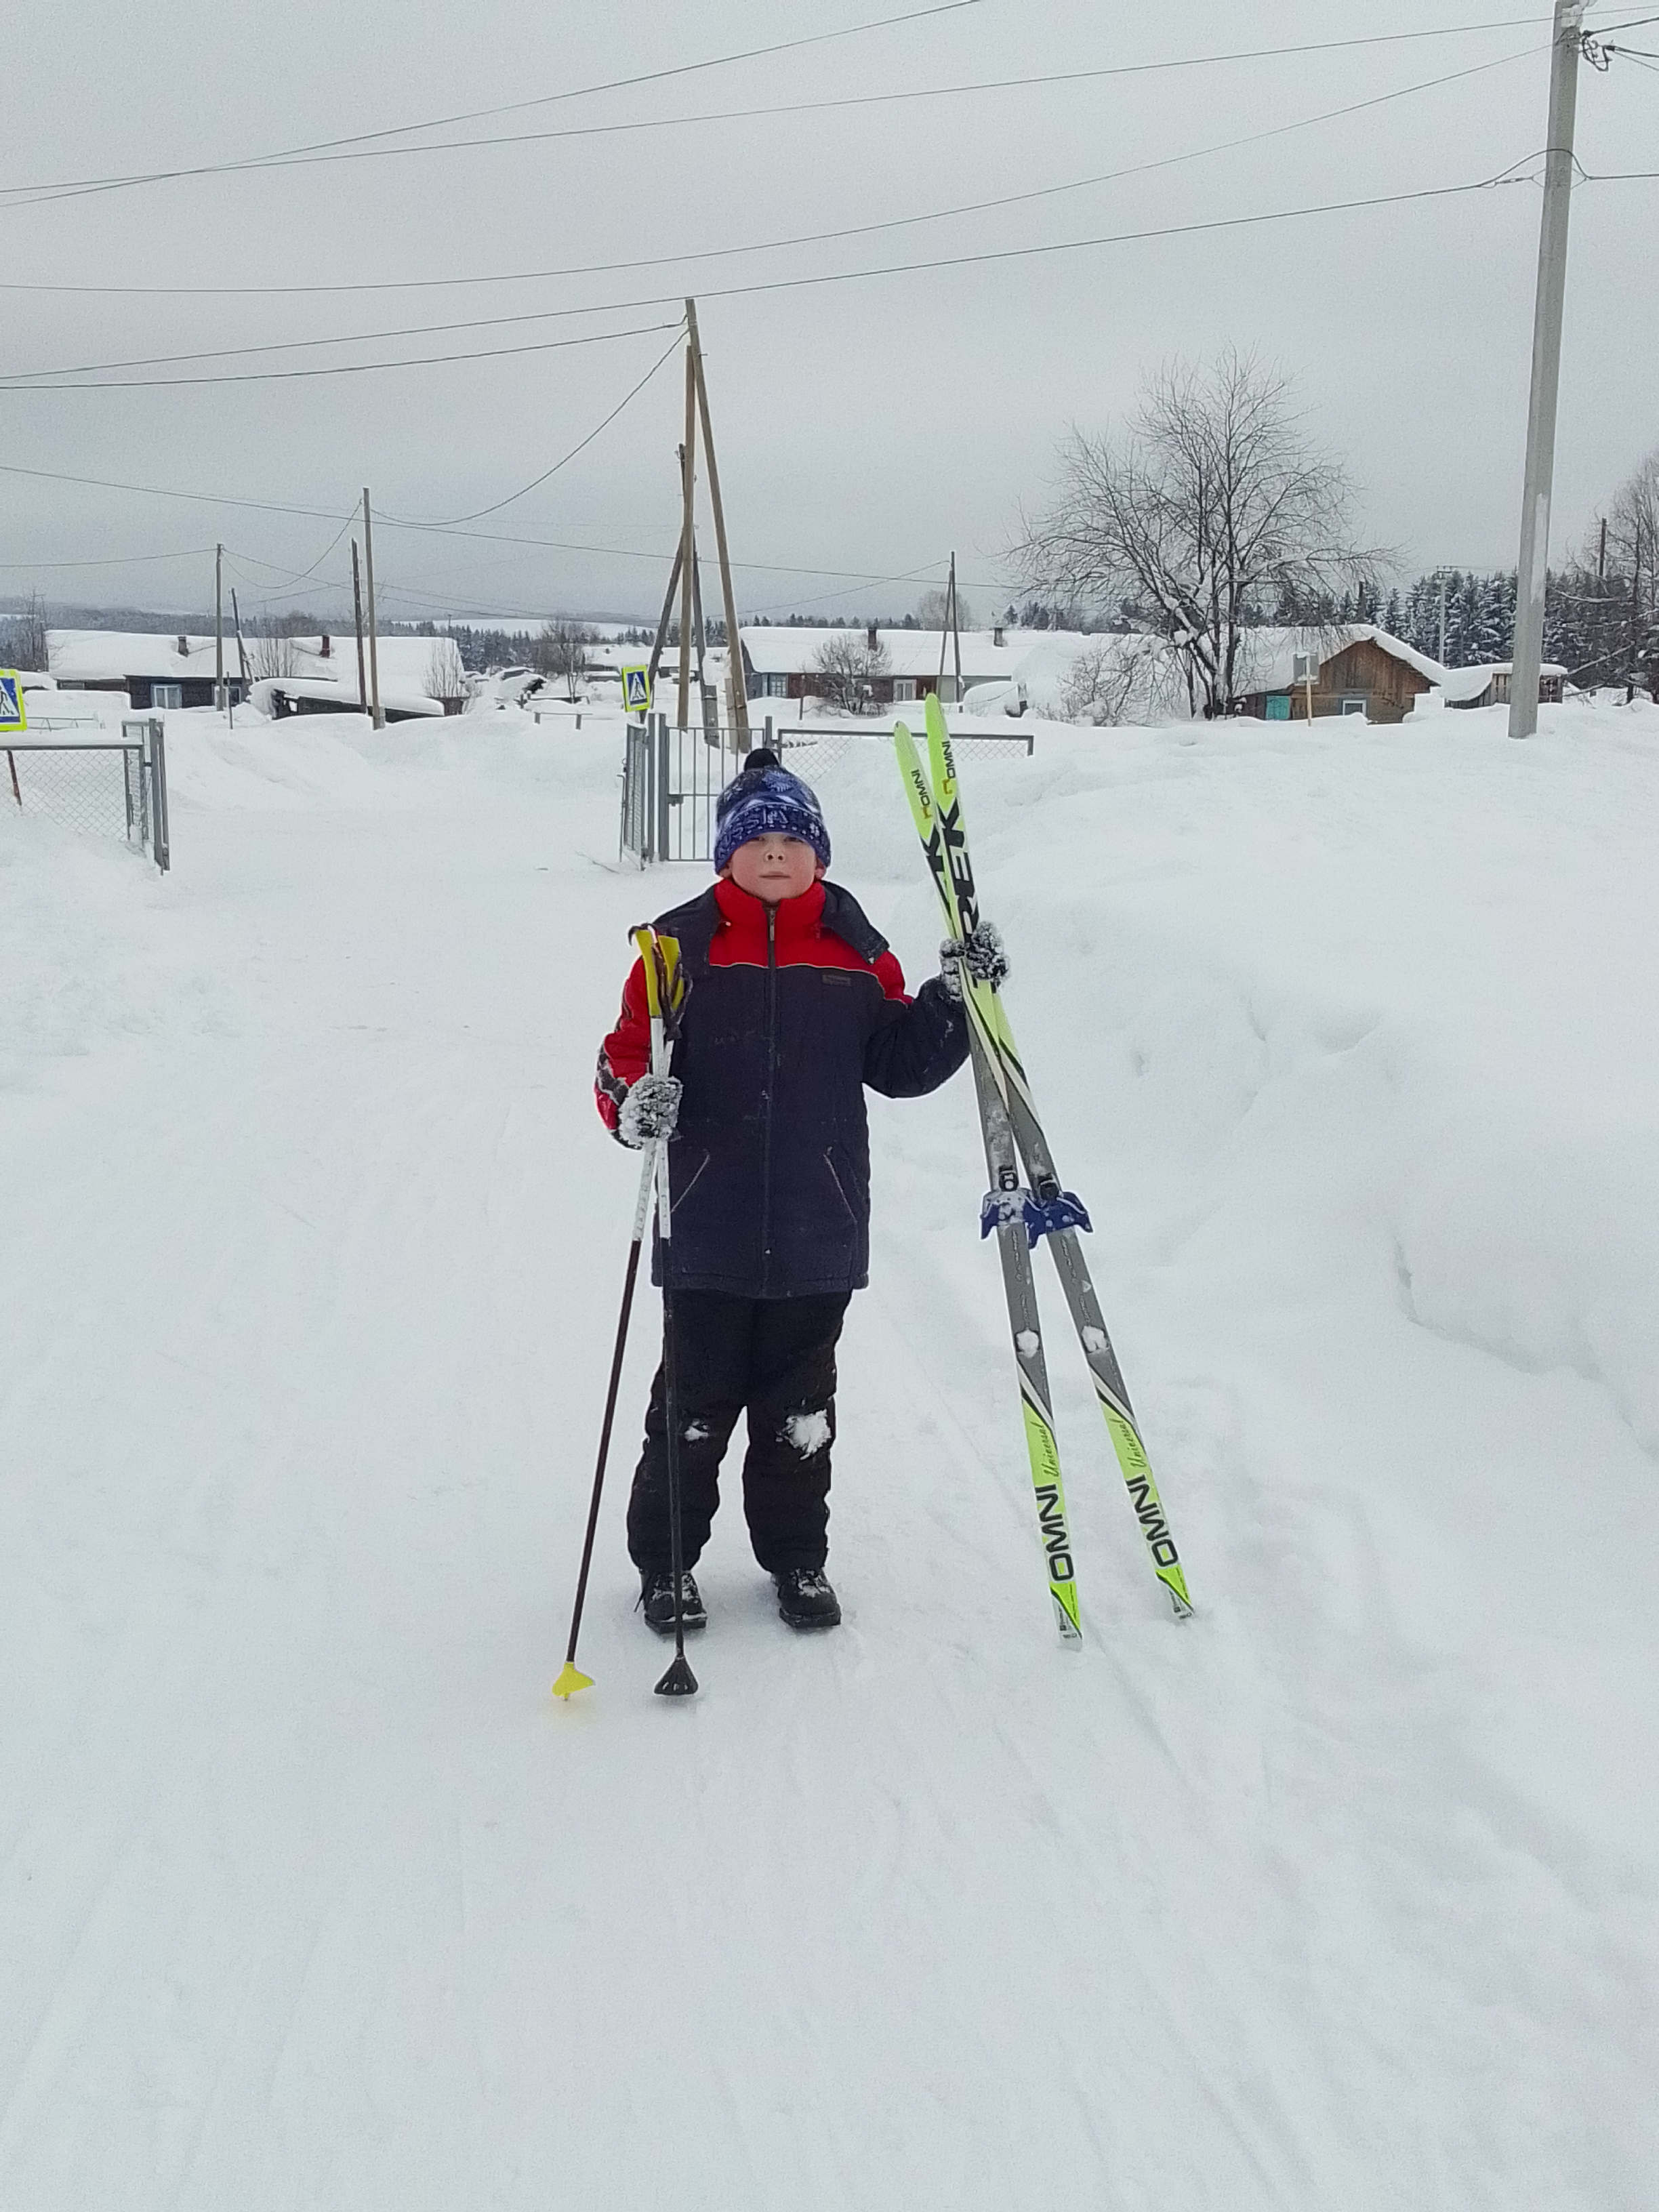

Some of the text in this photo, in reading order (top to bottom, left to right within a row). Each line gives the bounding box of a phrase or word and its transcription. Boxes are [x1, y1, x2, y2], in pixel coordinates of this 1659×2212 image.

[911, 769, 930, 806] OMNI
[942, 741, 956, 779] OMNI
[936, 796, 980, 945] REK
[1030, 1420, 1059, 1477] Universal
[1109, 1418, 1147, 1468] Universal
[1035, 1484, 1074, 1580] OMNI
[1126, 1475, 1178, 1567] OMNI
